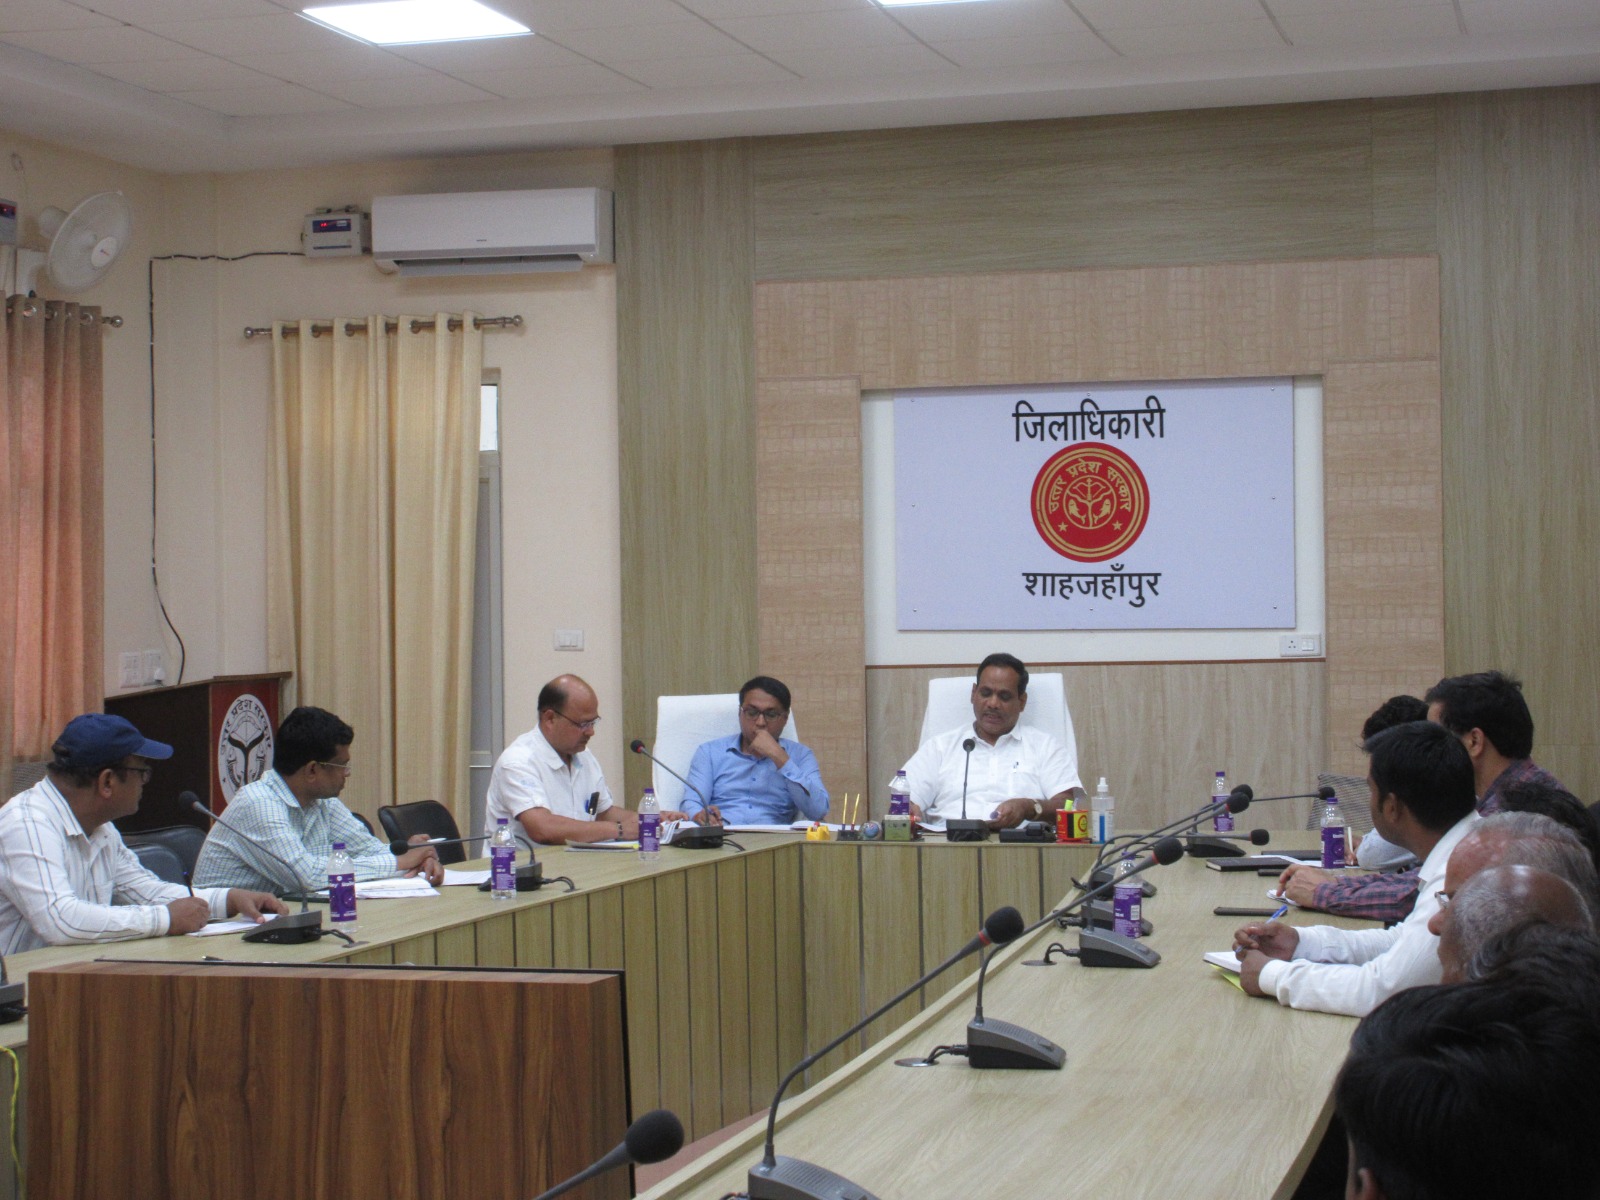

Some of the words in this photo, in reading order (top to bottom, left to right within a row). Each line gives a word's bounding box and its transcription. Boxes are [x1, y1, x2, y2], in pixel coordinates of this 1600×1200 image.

[1012, 395, 1166, 441] जिलाधिकारी
[1066, 458, 1102, 477] प्रदेश
[1107, 466, 1132, 512] सरकार
[1022, 563, 1162, 608] शाहजहाँपुर
